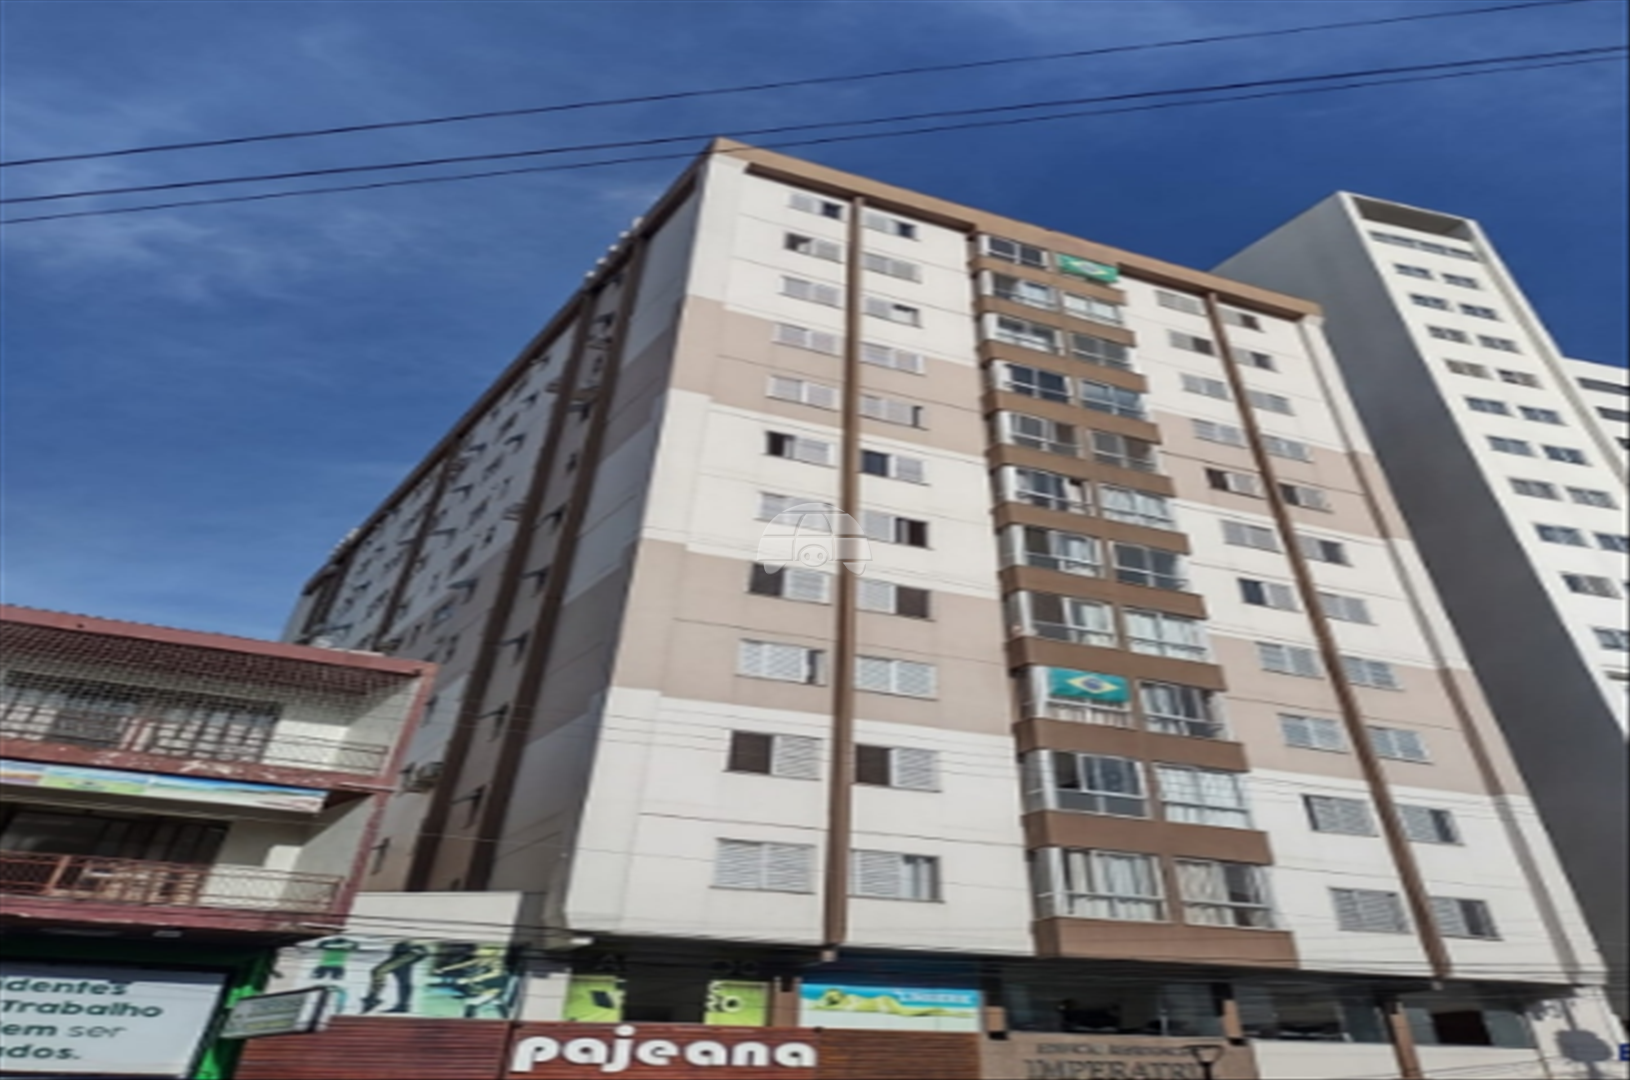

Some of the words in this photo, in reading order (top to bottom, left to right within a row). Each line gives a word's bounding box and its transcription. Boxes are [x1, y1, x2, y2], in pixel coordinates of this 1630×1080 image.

[1, 1000, 164, 1018] Trabalho
[0, 1022, 58, 1037] em
[68, 1025, 128, 1038] ser
[510, 1024, 818, 1073] pajeana
[1023, 1059, 1208, 1079] IMPERATRI
